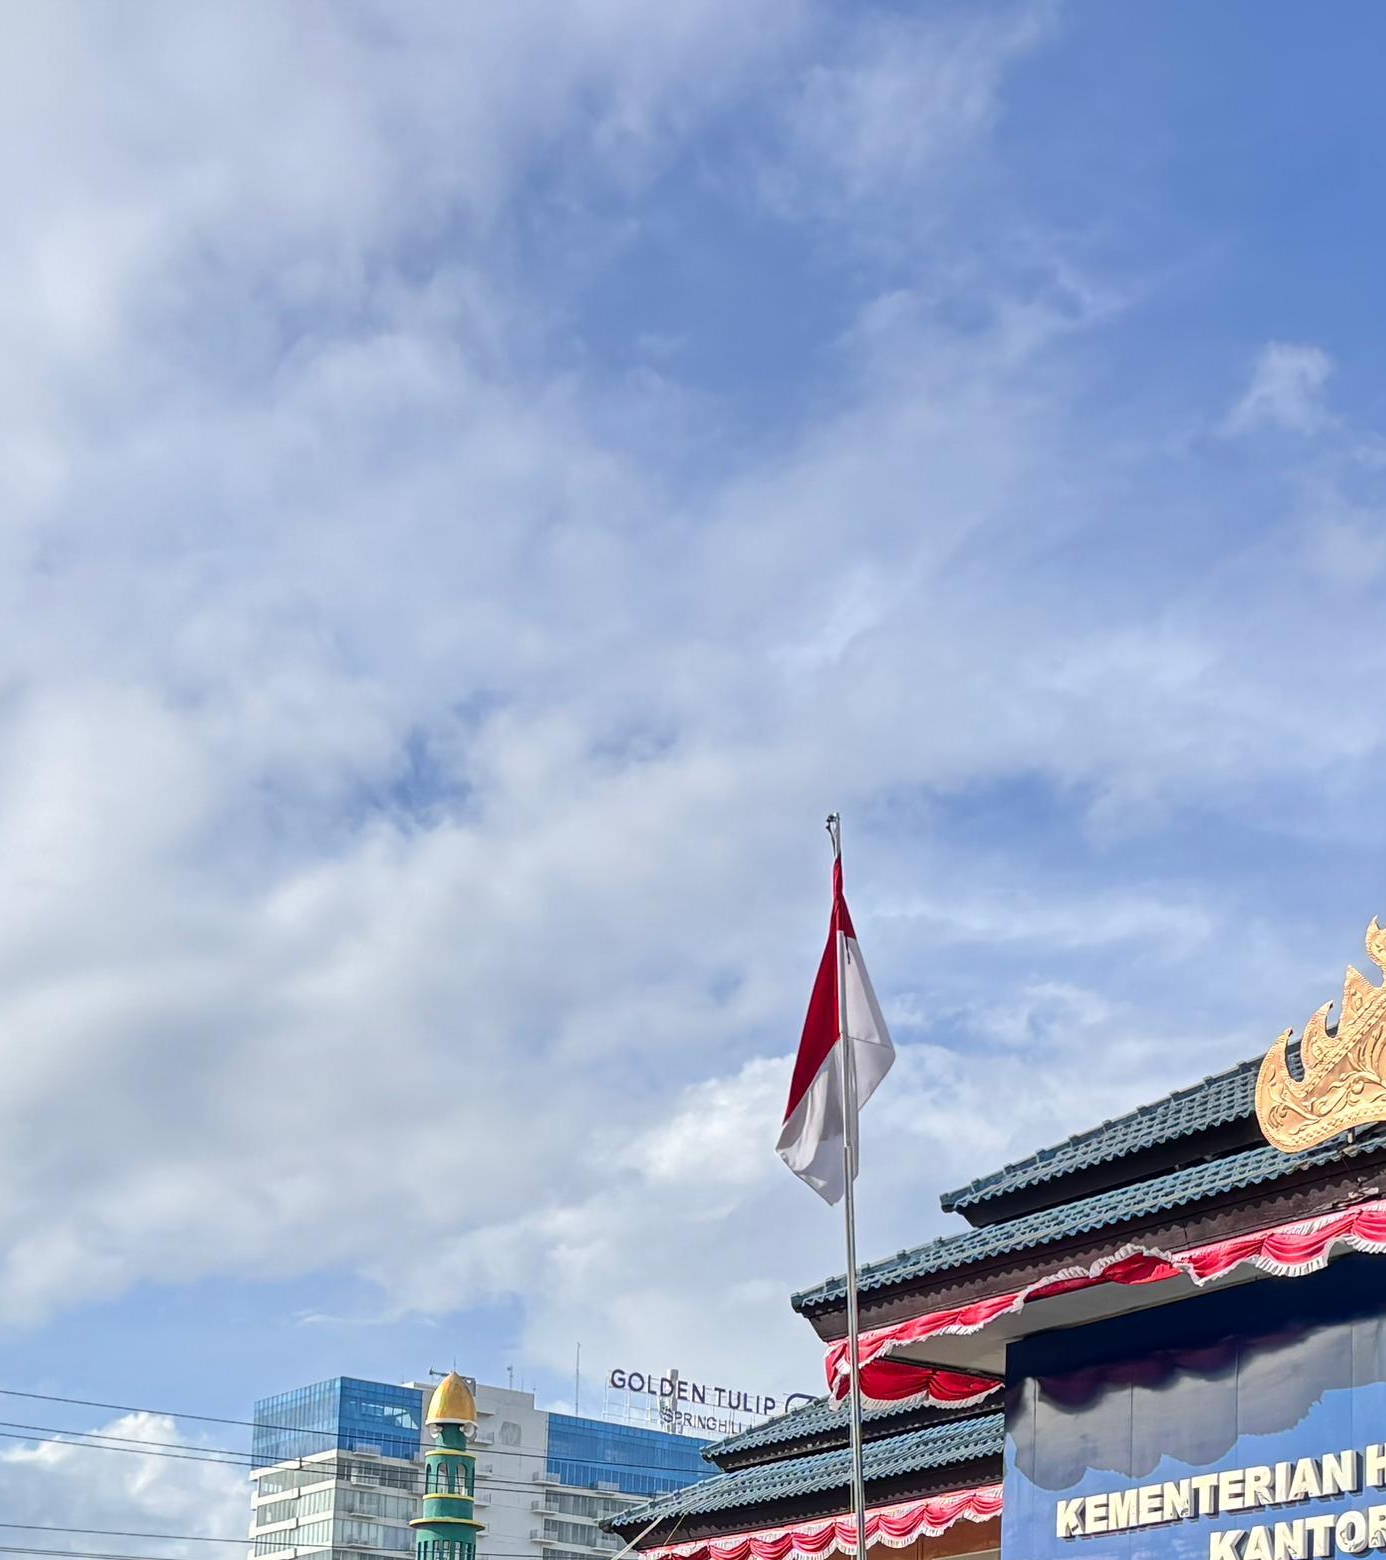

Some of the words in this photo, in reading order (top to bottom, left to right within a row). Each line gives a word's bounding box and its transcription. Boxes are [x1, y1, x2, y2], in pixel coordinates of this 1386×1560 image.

[610, 1368, 706, 1401] GOLDEN
[714, 1387, 776, 1416] TULIP
[1055, 1447, 1361, 1541] KEMENTERIAN
